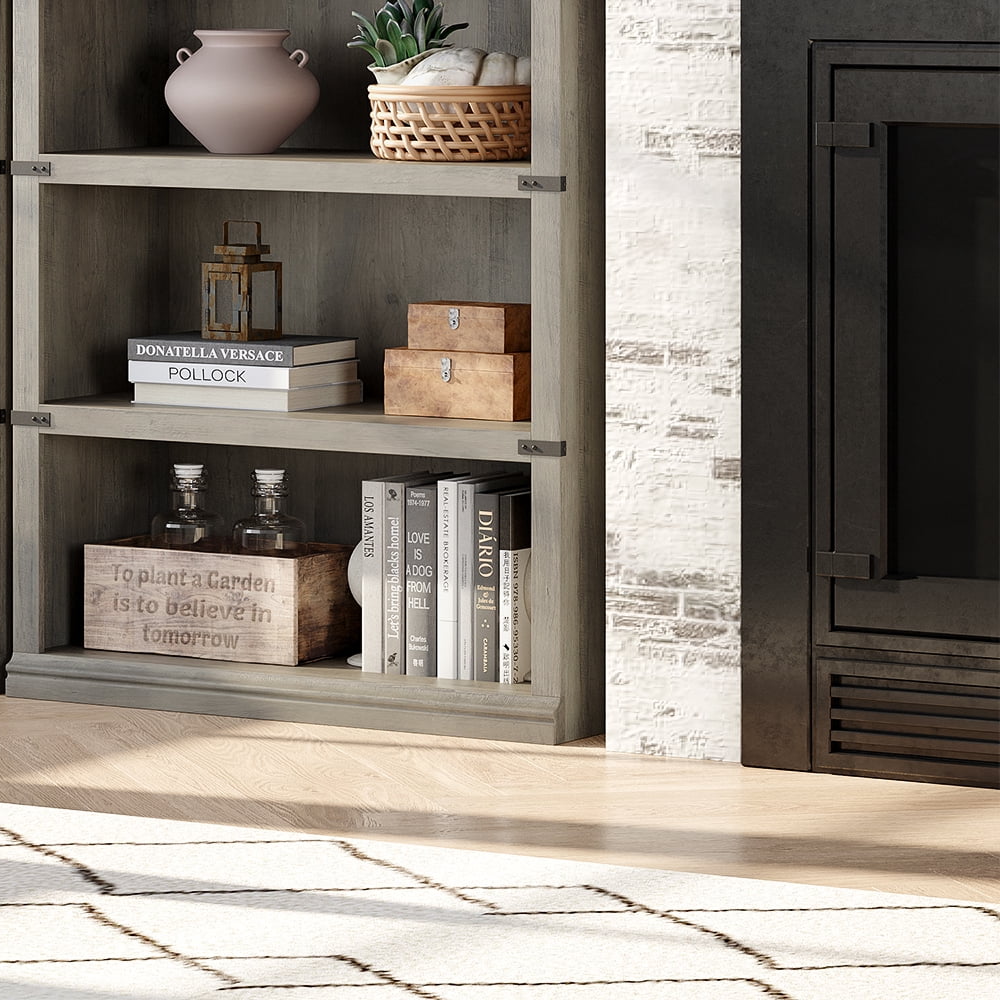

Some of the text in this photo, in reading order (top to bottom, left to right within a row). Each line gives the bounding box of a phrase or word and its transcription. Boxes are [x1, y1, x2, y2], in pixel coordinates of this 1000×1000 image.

[136, 344, 284, 362] DONATELLA VERSACE
[168, 367, 246, 383] POLLOCK
[363, 496, 374, 558] LOS AMANTES
[387, 516, 400, 550] home!
[407, 532, 430, 544] LOVE
[414, 548, 422, 560] IS
[478, 510, 497, 578] DIÁRIO
[112, 564, 275, 593] To plant a Garden
[387, 551, 400, 584] blacks
[406, 565, 433, 576] A DOG
[387, 585, 402, 613] bring
[406, 581, 432, 594] FROM
[113, 592, 272, 623] is to believe in
[407, 597, 430, 610] HELL
[142, 624, 239, 649] tomorrow
